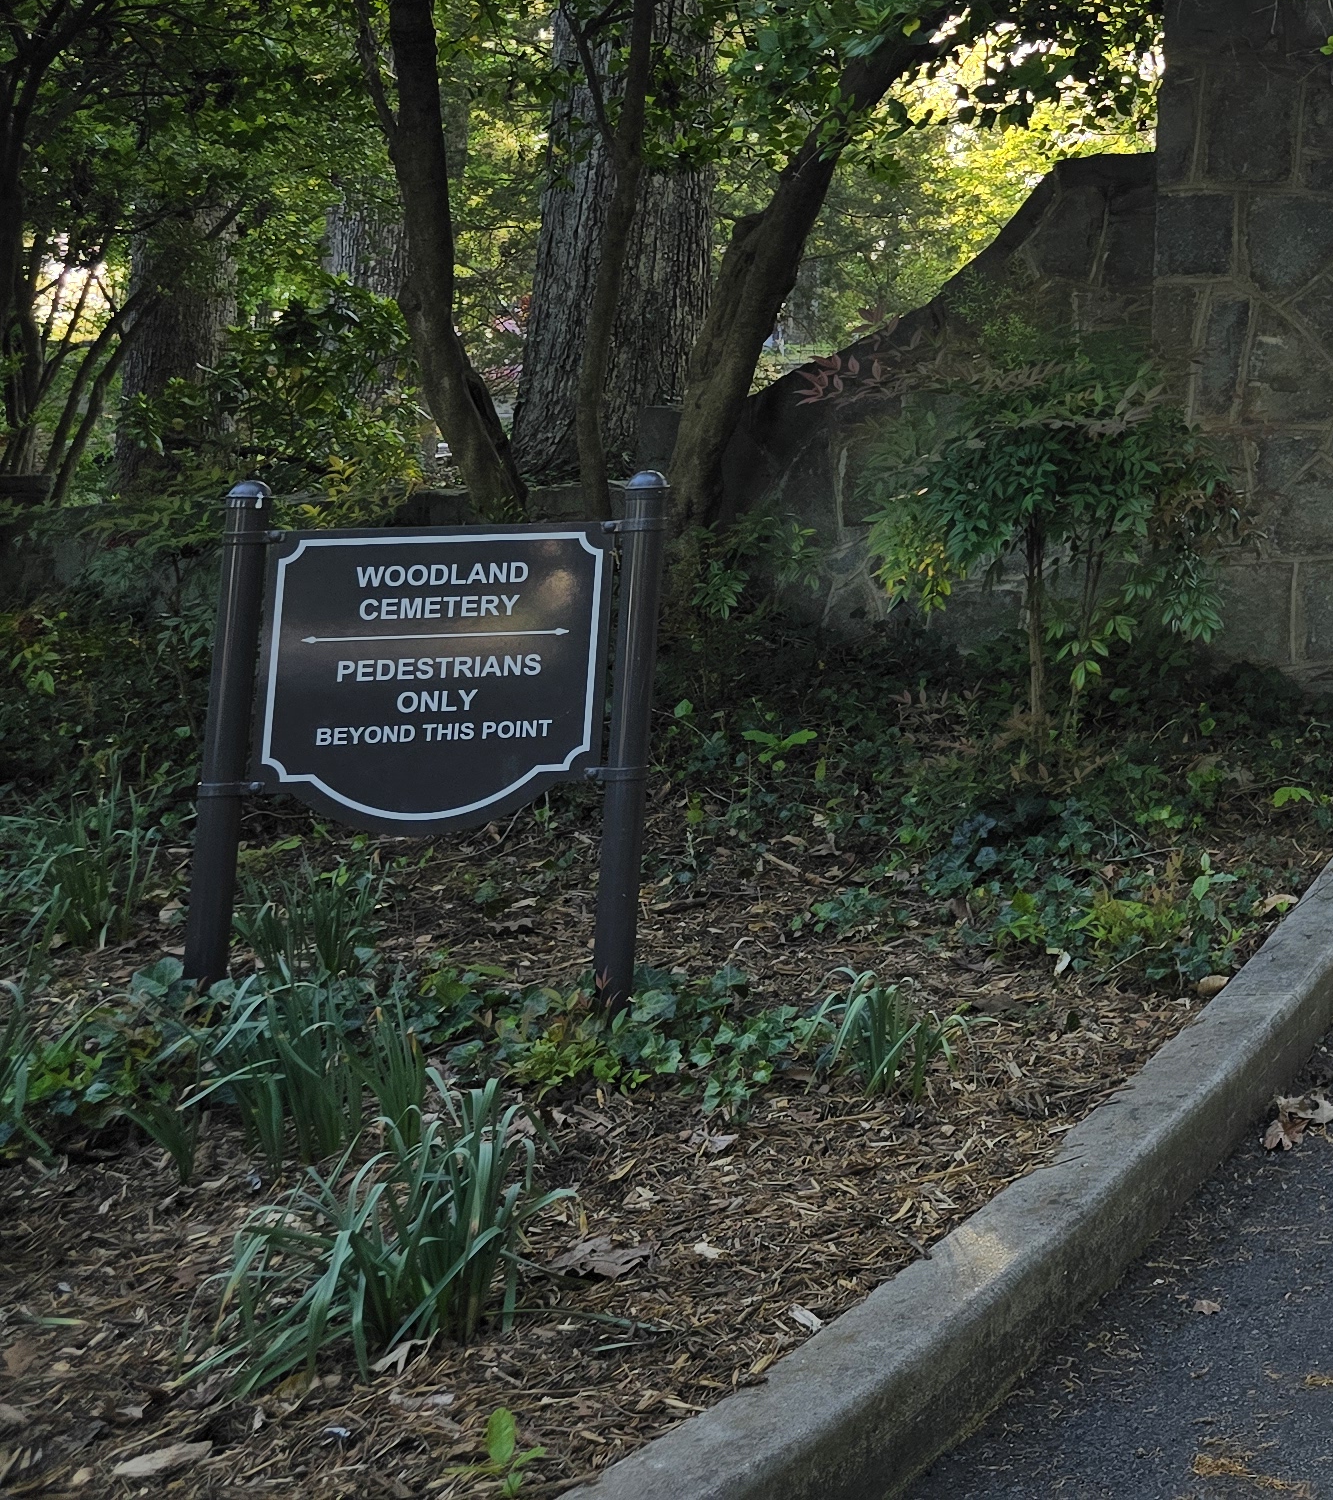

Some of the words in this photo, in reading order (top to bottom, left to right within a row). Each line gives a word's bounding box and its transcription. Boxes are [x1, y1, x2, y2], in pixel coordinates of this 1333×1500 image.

[356, 561, 529, 588] WOODLAND
[359, 594, 520, 621] CEMETERY
[336, 653, 542, 682] PEDESTRIANS
[396, 689, 479, 714] ONLY
[315, 724, 416, 746] BEYOND
[422, 722, 475, 742] THIS
[482, 719, 553, 740] POINT
